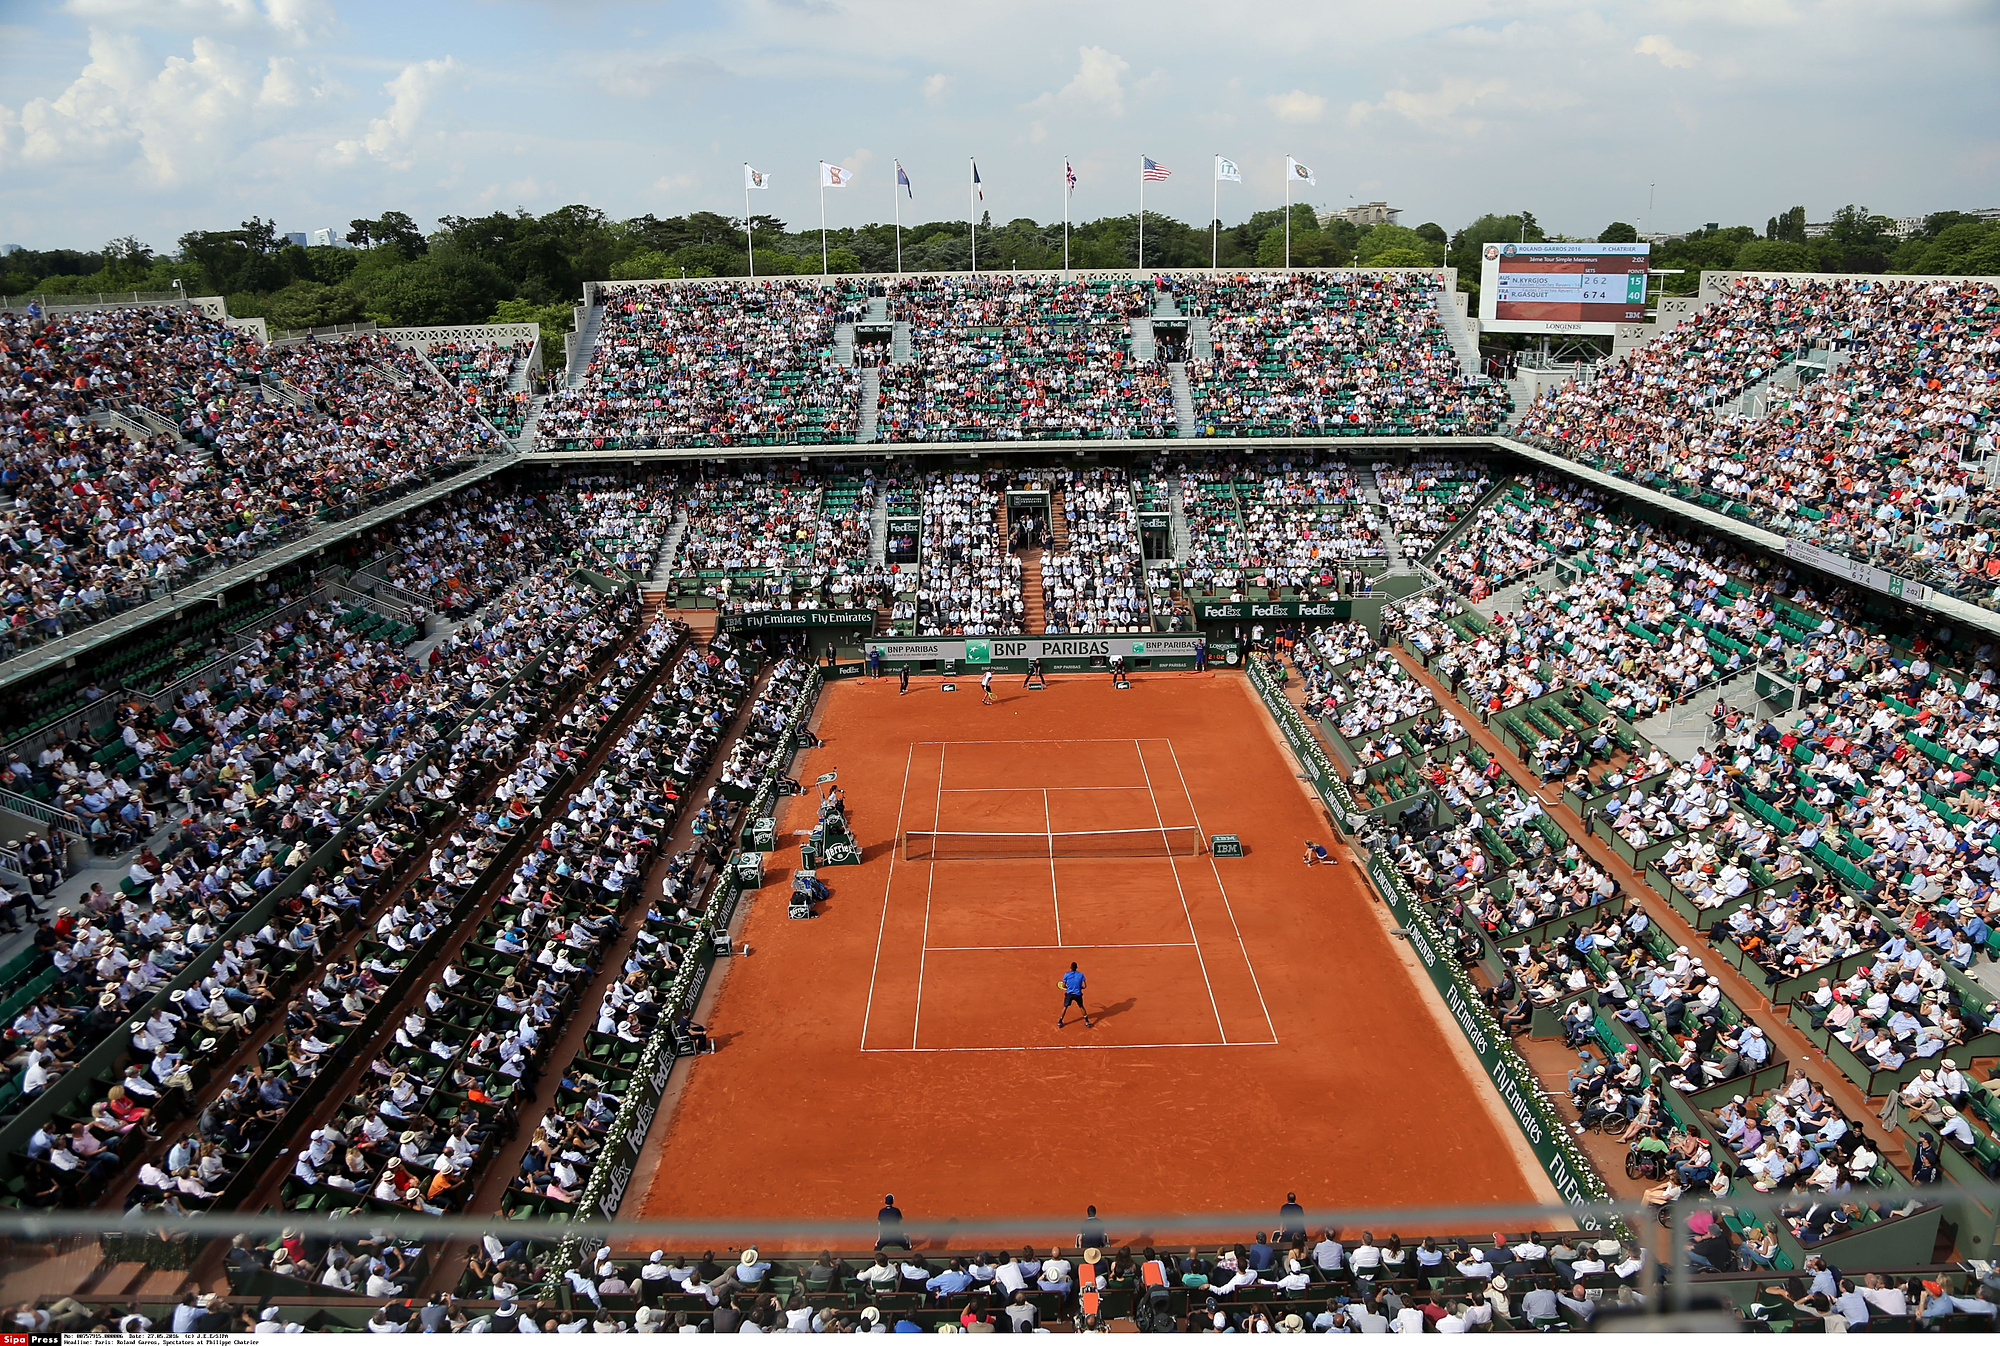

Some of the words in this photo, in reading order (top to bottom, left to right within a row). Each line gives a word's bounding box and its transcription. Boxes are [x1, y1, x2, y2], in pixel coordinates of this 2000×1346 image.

[1630, 277, 1642, 285] 15
[890, 522, 919, 532] FedEx
[1139, 518, 1167, 528] FedEx
[1853, 562, 1858, 571] 2
[1860, 564, 1865, 573] 6
[1867, 567, 1872, 576] 2
[1851, 571, 1857, 579] 6
[1865, 576, 1871, 584] 4
[1891, 577, 1901, 587] 15
[1890, 586, 1900, 595] 40
[1906, 587, 1919, 596] 2:02
[1204, 605, 1242, 617] FedEx
[1251, 604, 1289, 616] FedEx
[1298, 604, 1336, 616] FedEx
[724, 617, 743, 627] IBM
[747, 616, 763, 628] Fly
[764, 615, 807, 625] Emirates
[811, 613, 829, 625] Fly
[829, 612, 872, 623] Emirates
[905, 645, 938, 653] PARIBAS
[994, 642, 1027, 657] BNP
[1042, 641, 1110, 656] PARIBAS
[1146, 641, 1162, 649] BNP
[1164, 641, 1196, 649] PARIBAS
[1250, 668, 1265, 692] PEUGEOT
[1265, 693, 1281, 719] PEUGEOT
[1283, 720, 1301, 750] PEUGEOT
[1302, 751, 1320, 781] LONGINES
[1325, 786, 1346, 821] LONGINES
[1217, 844, 1238, 853] IBM
[1372, 863, 1399, 907] LONGINES
[717, 884, 738, 929] LONGINES
[1406, 917, 1437, 967] LONGINES
[1446, 983, 1461, 1012] Fly
[1456, 1002, 1488, 1055] Emirates
[649, 1045, 676, 1097] FedEx
[1492, 1059, 1510, 1092] Fly
[1505, 1081, 1543, 1145] Emirates
[625, 1098, 656, 1155] FedEx
[1549, 1152, 1570, 1190] Fly
[598, 1158, 632, 1223] FedEx
